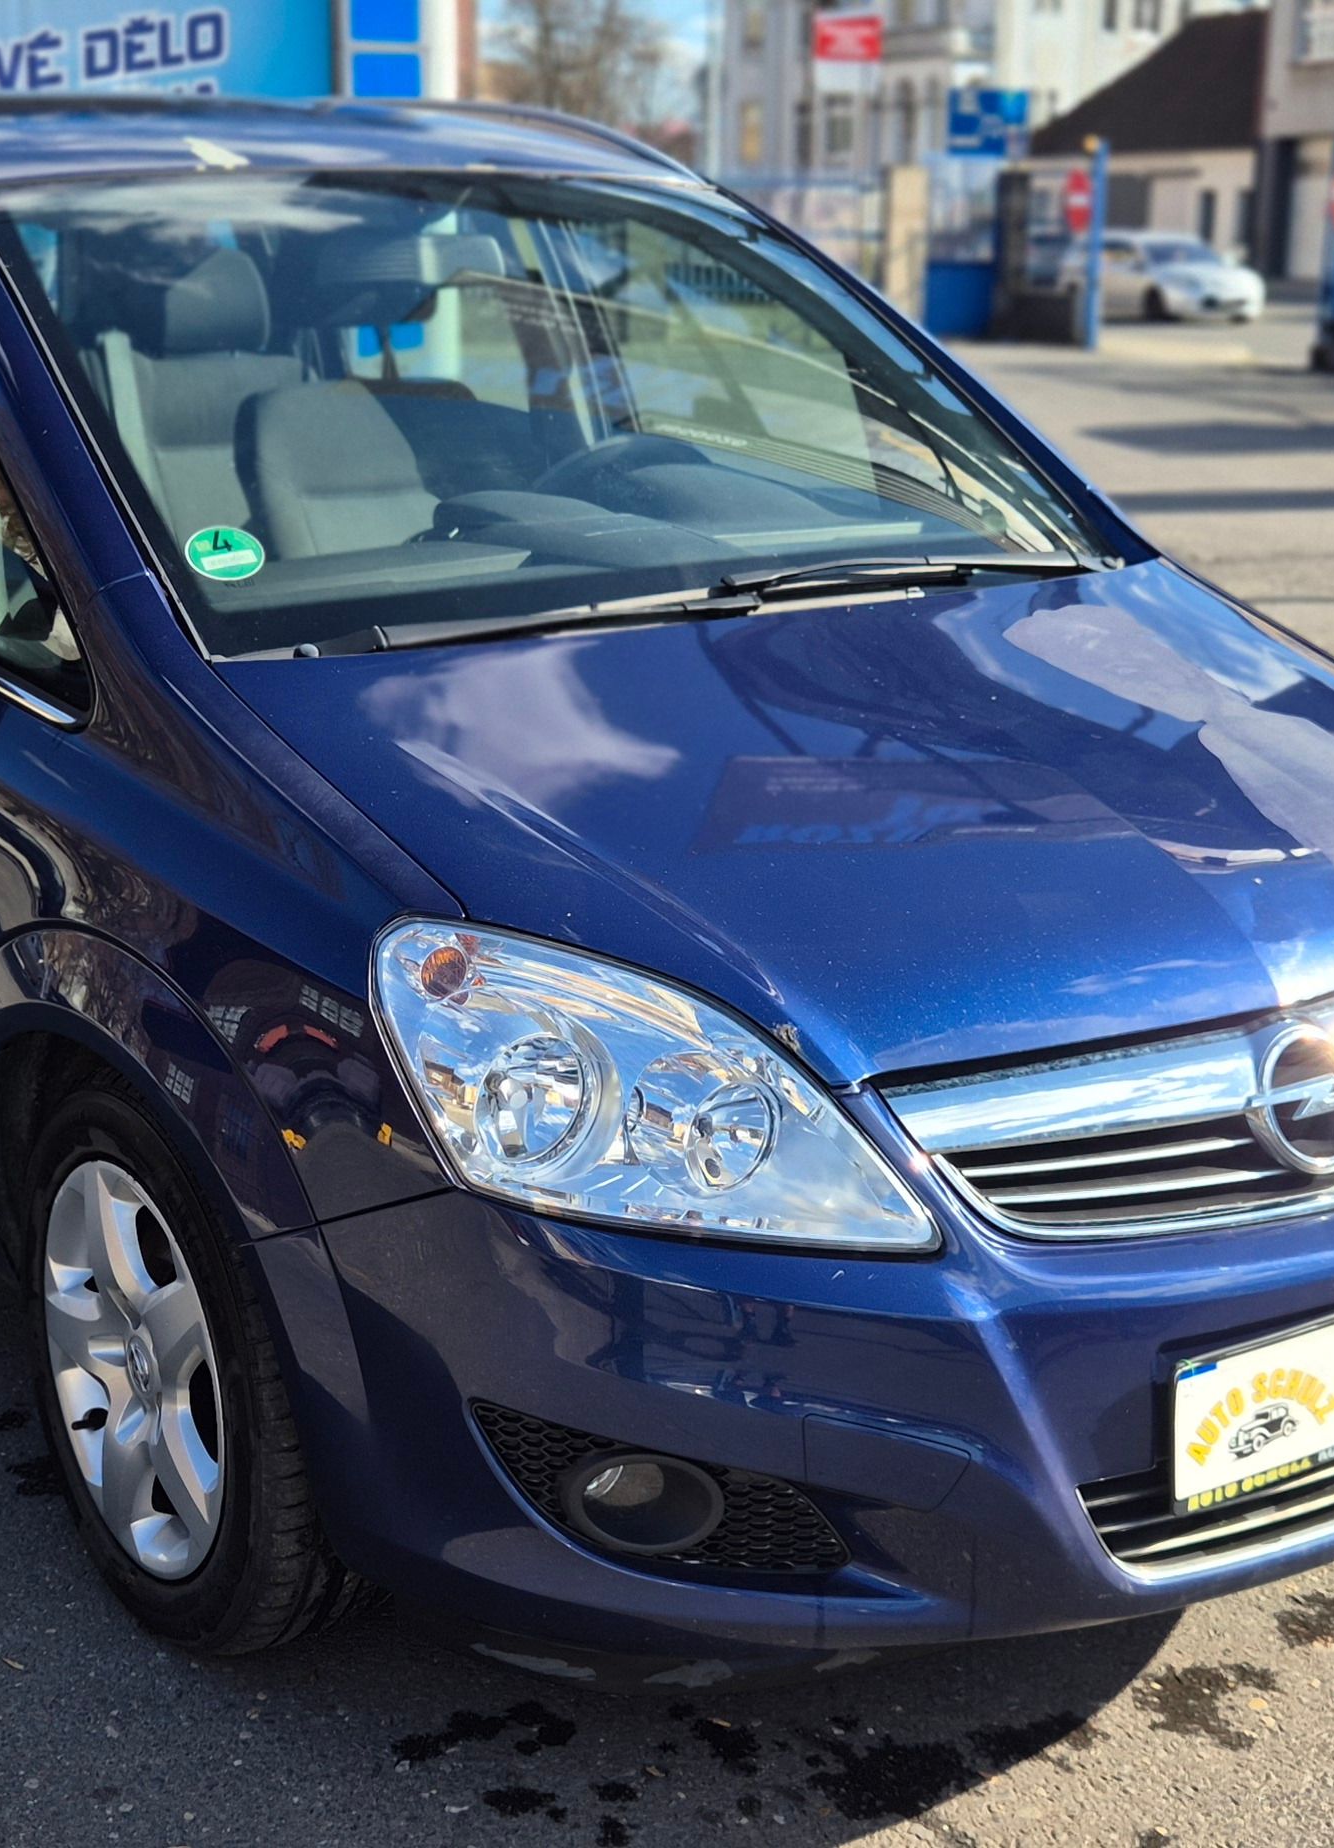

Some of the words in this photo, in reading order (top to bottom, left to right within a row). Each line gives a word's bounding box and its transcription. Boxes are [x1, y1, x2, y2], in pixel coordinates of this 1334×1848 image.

[84, 11, 223, 79] DĚLO
[213, 531, 233, 551] 4
[1186, 1387, 1245, 1466] AUTO
